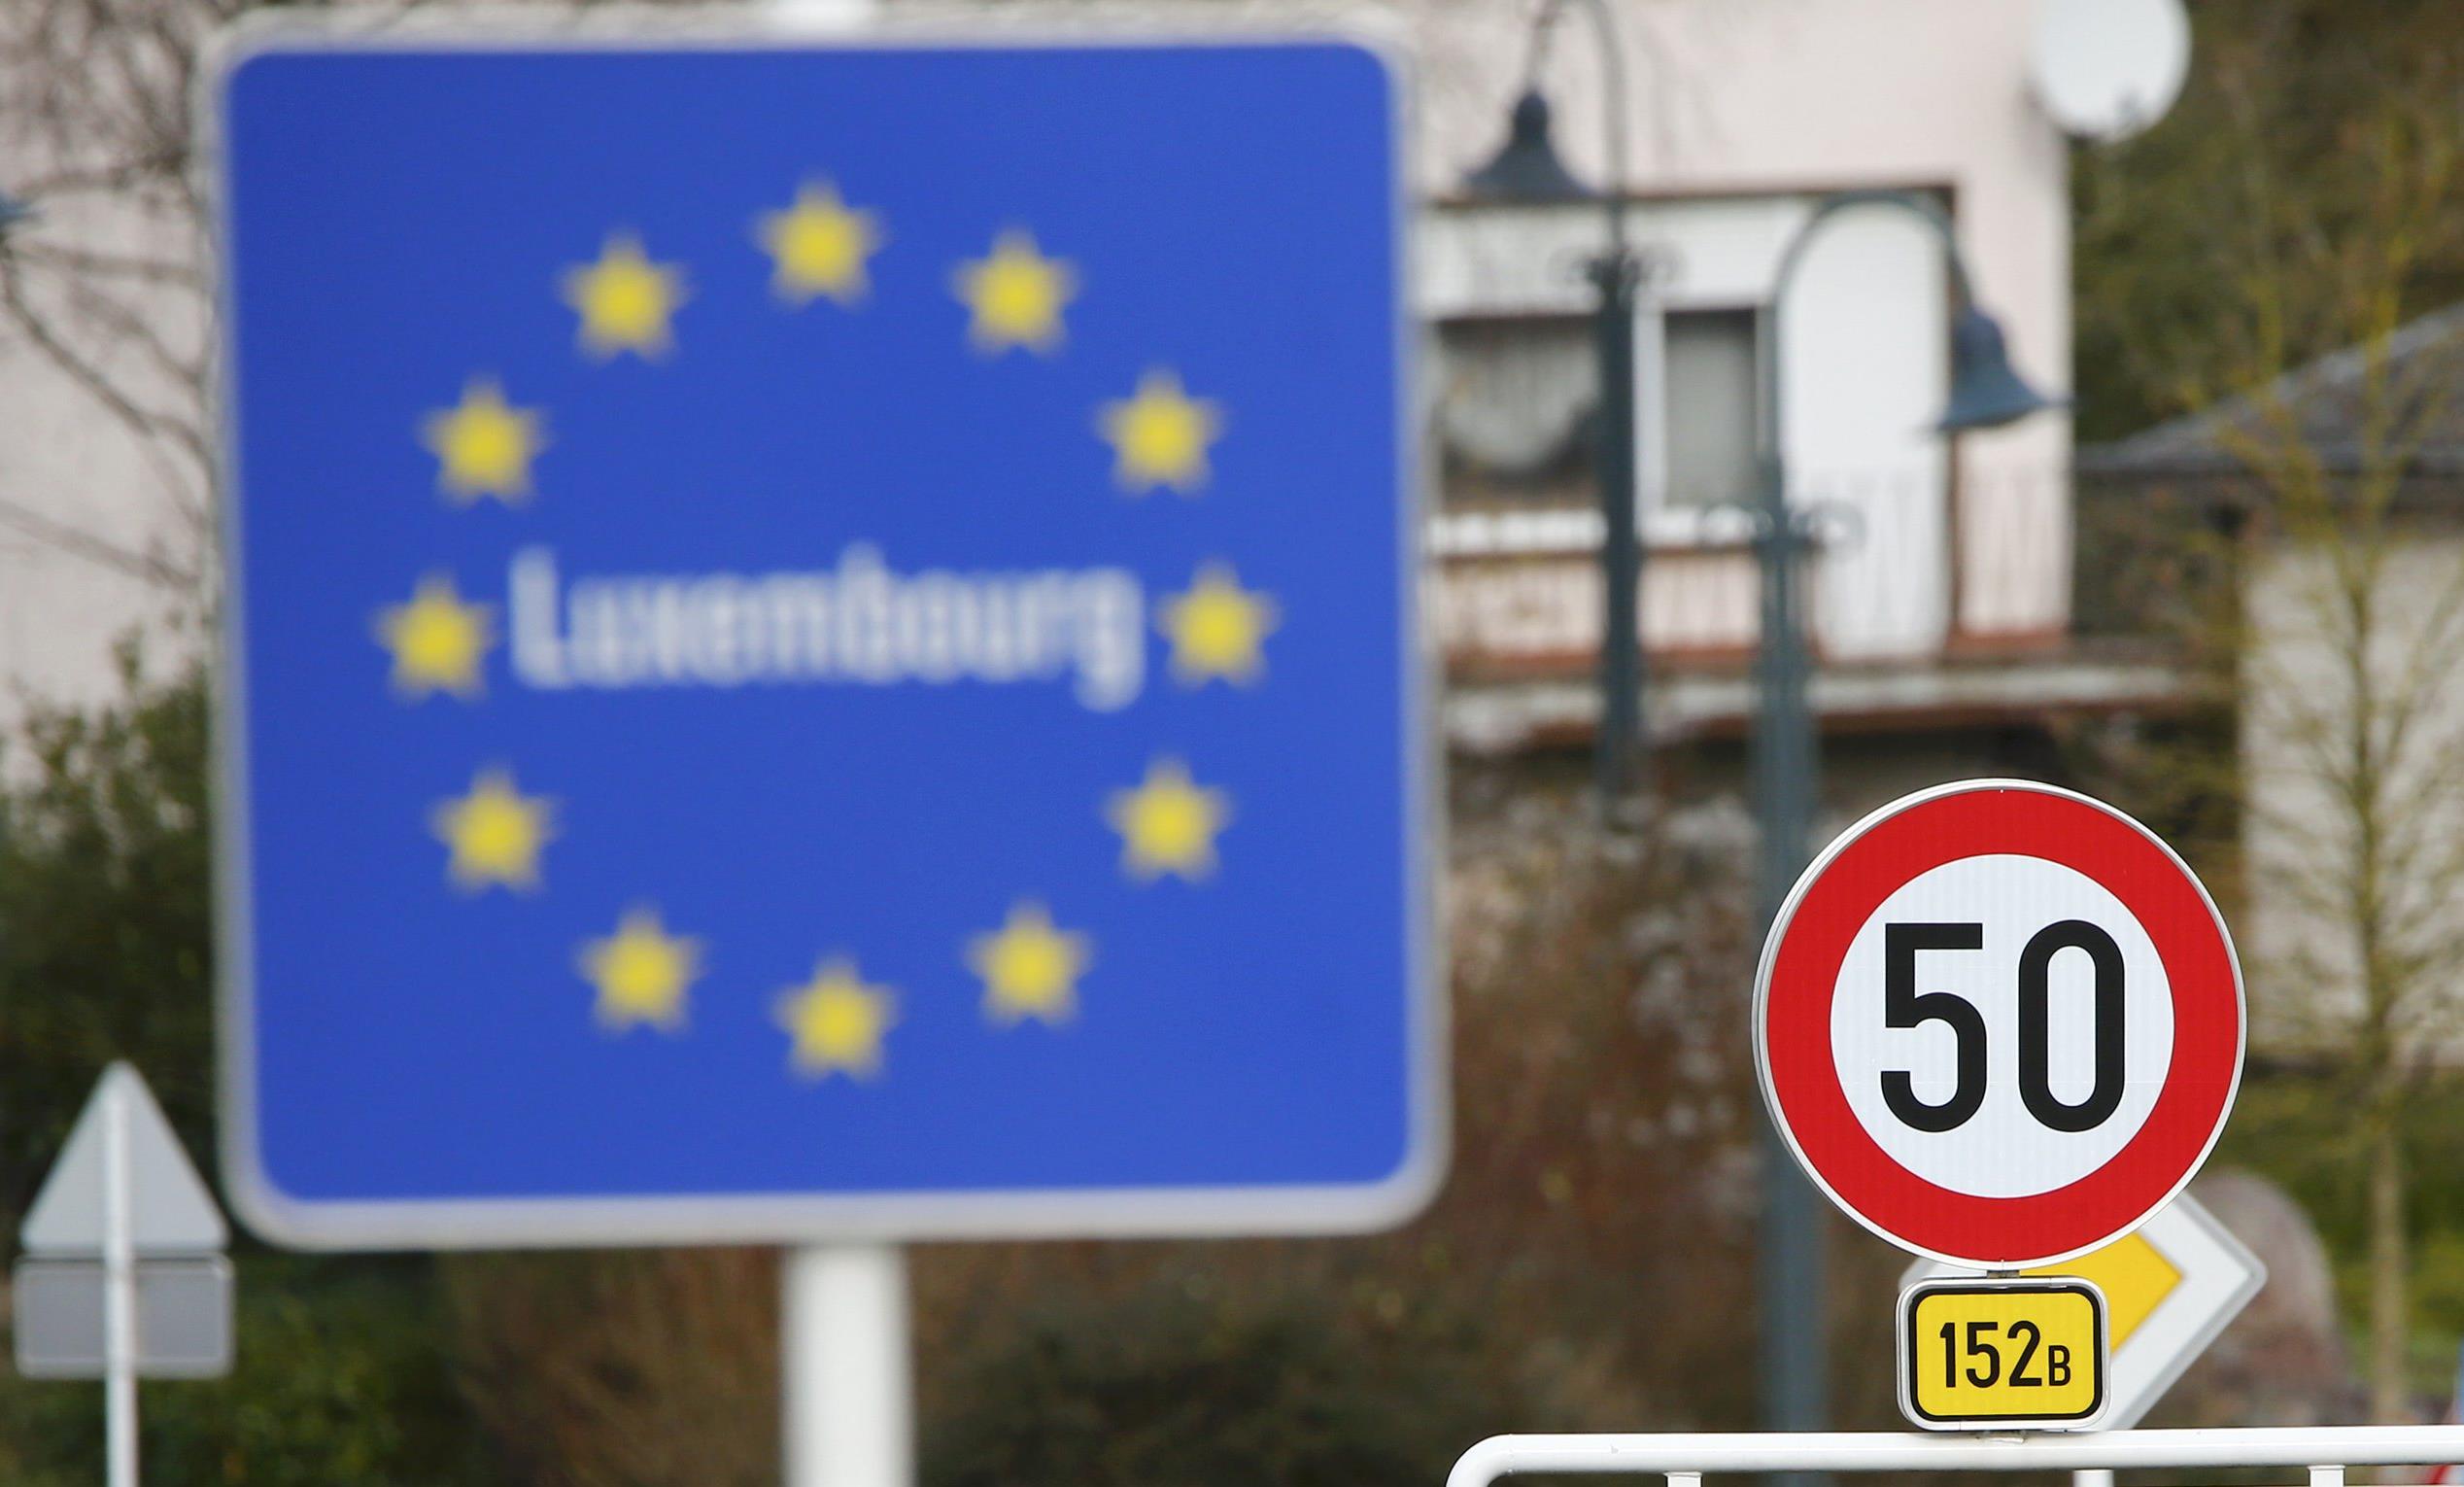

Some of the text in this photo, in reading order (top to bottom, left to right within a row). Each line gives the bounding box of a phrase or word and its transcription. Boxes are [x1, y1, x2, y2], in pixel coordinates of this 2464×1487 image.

[512, 548, 1145, 709] Luxembourg
[1881, 920, 2125, 1132] 50
[1940, 1321, 2070, 1388] 152B
